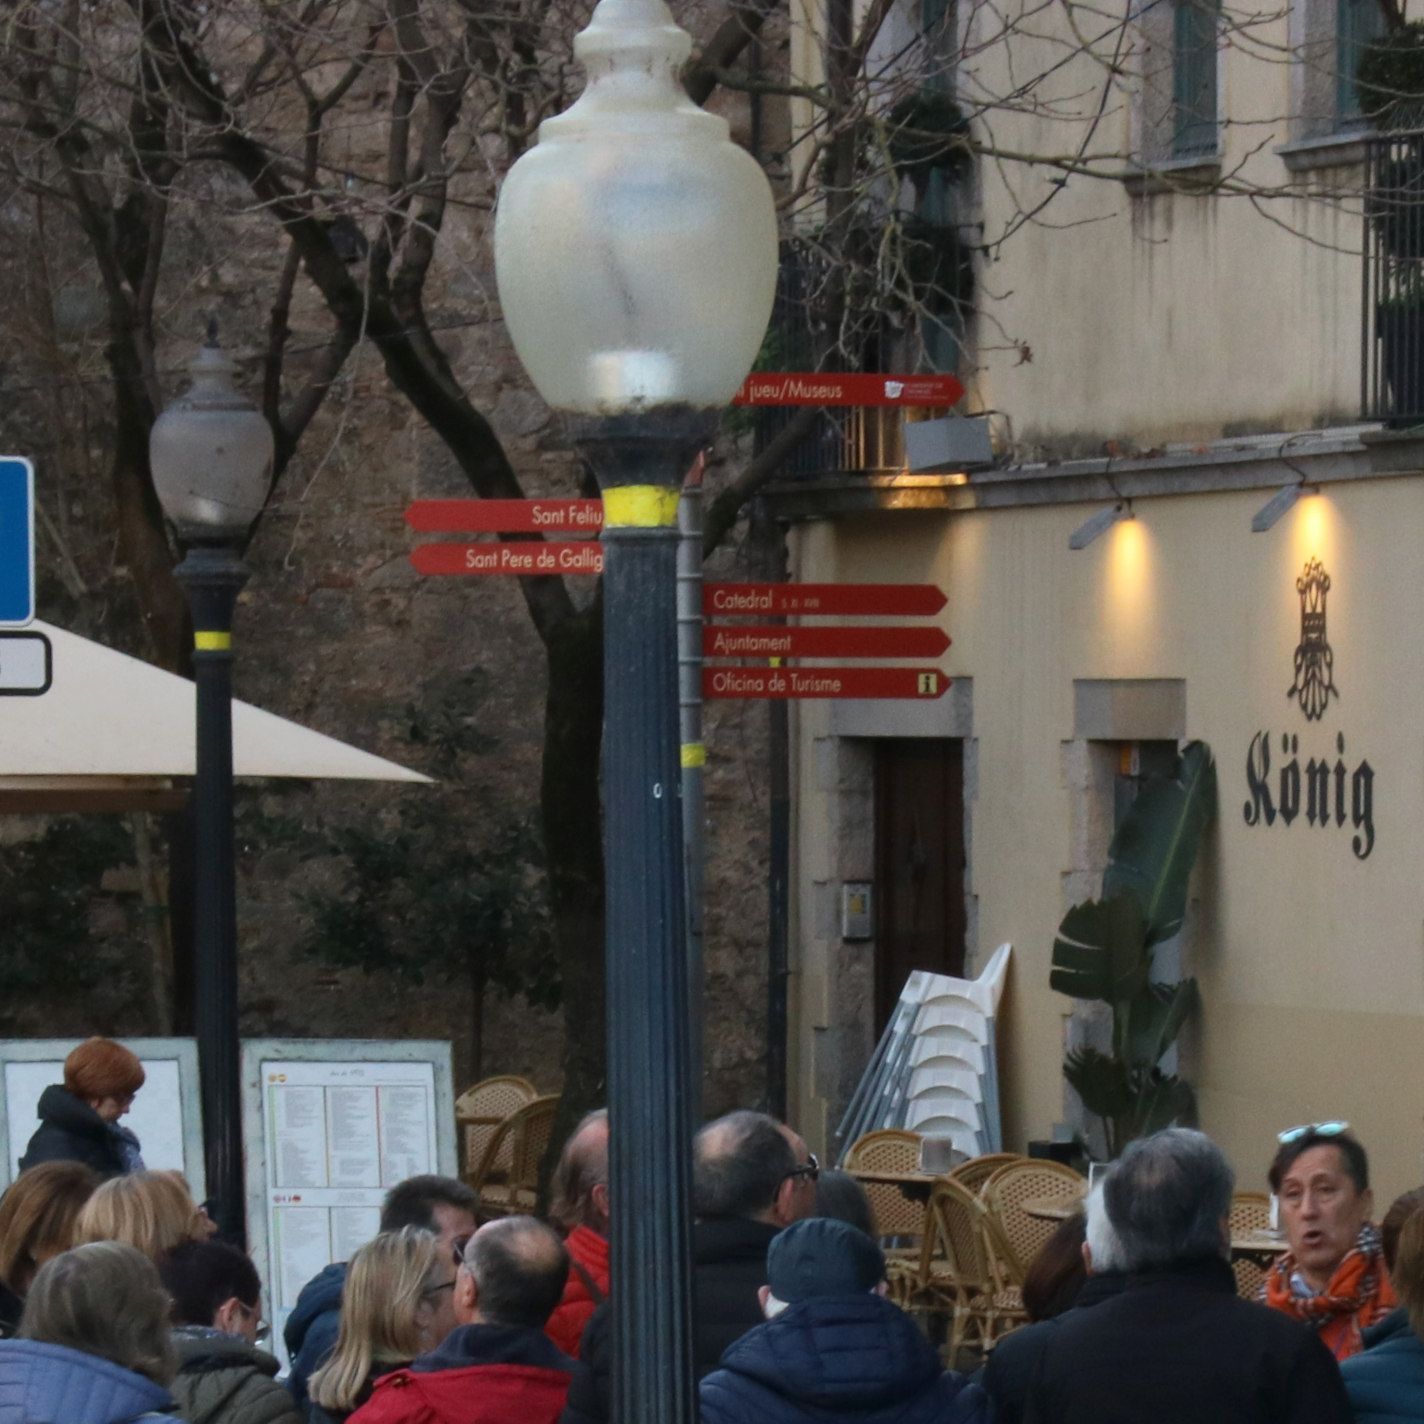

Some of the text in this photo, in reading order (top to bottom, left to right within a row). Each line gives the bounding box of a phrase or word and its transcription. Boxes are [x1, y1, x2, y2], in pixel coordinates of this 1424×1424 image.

[532, 505, 603, 525] Sant Feliu
[466, 548, 604, 573] Sant Pere de Gallig
[713, 590, 773, 610] Catedral
[714, 634, 792, 655] Ajuntament
[713, 672, 764, 692] Oficina
[768, 673, 786, 692] de
[791, 673, 842, 692] Turisme
[1243, 729, 1376, 861] König
